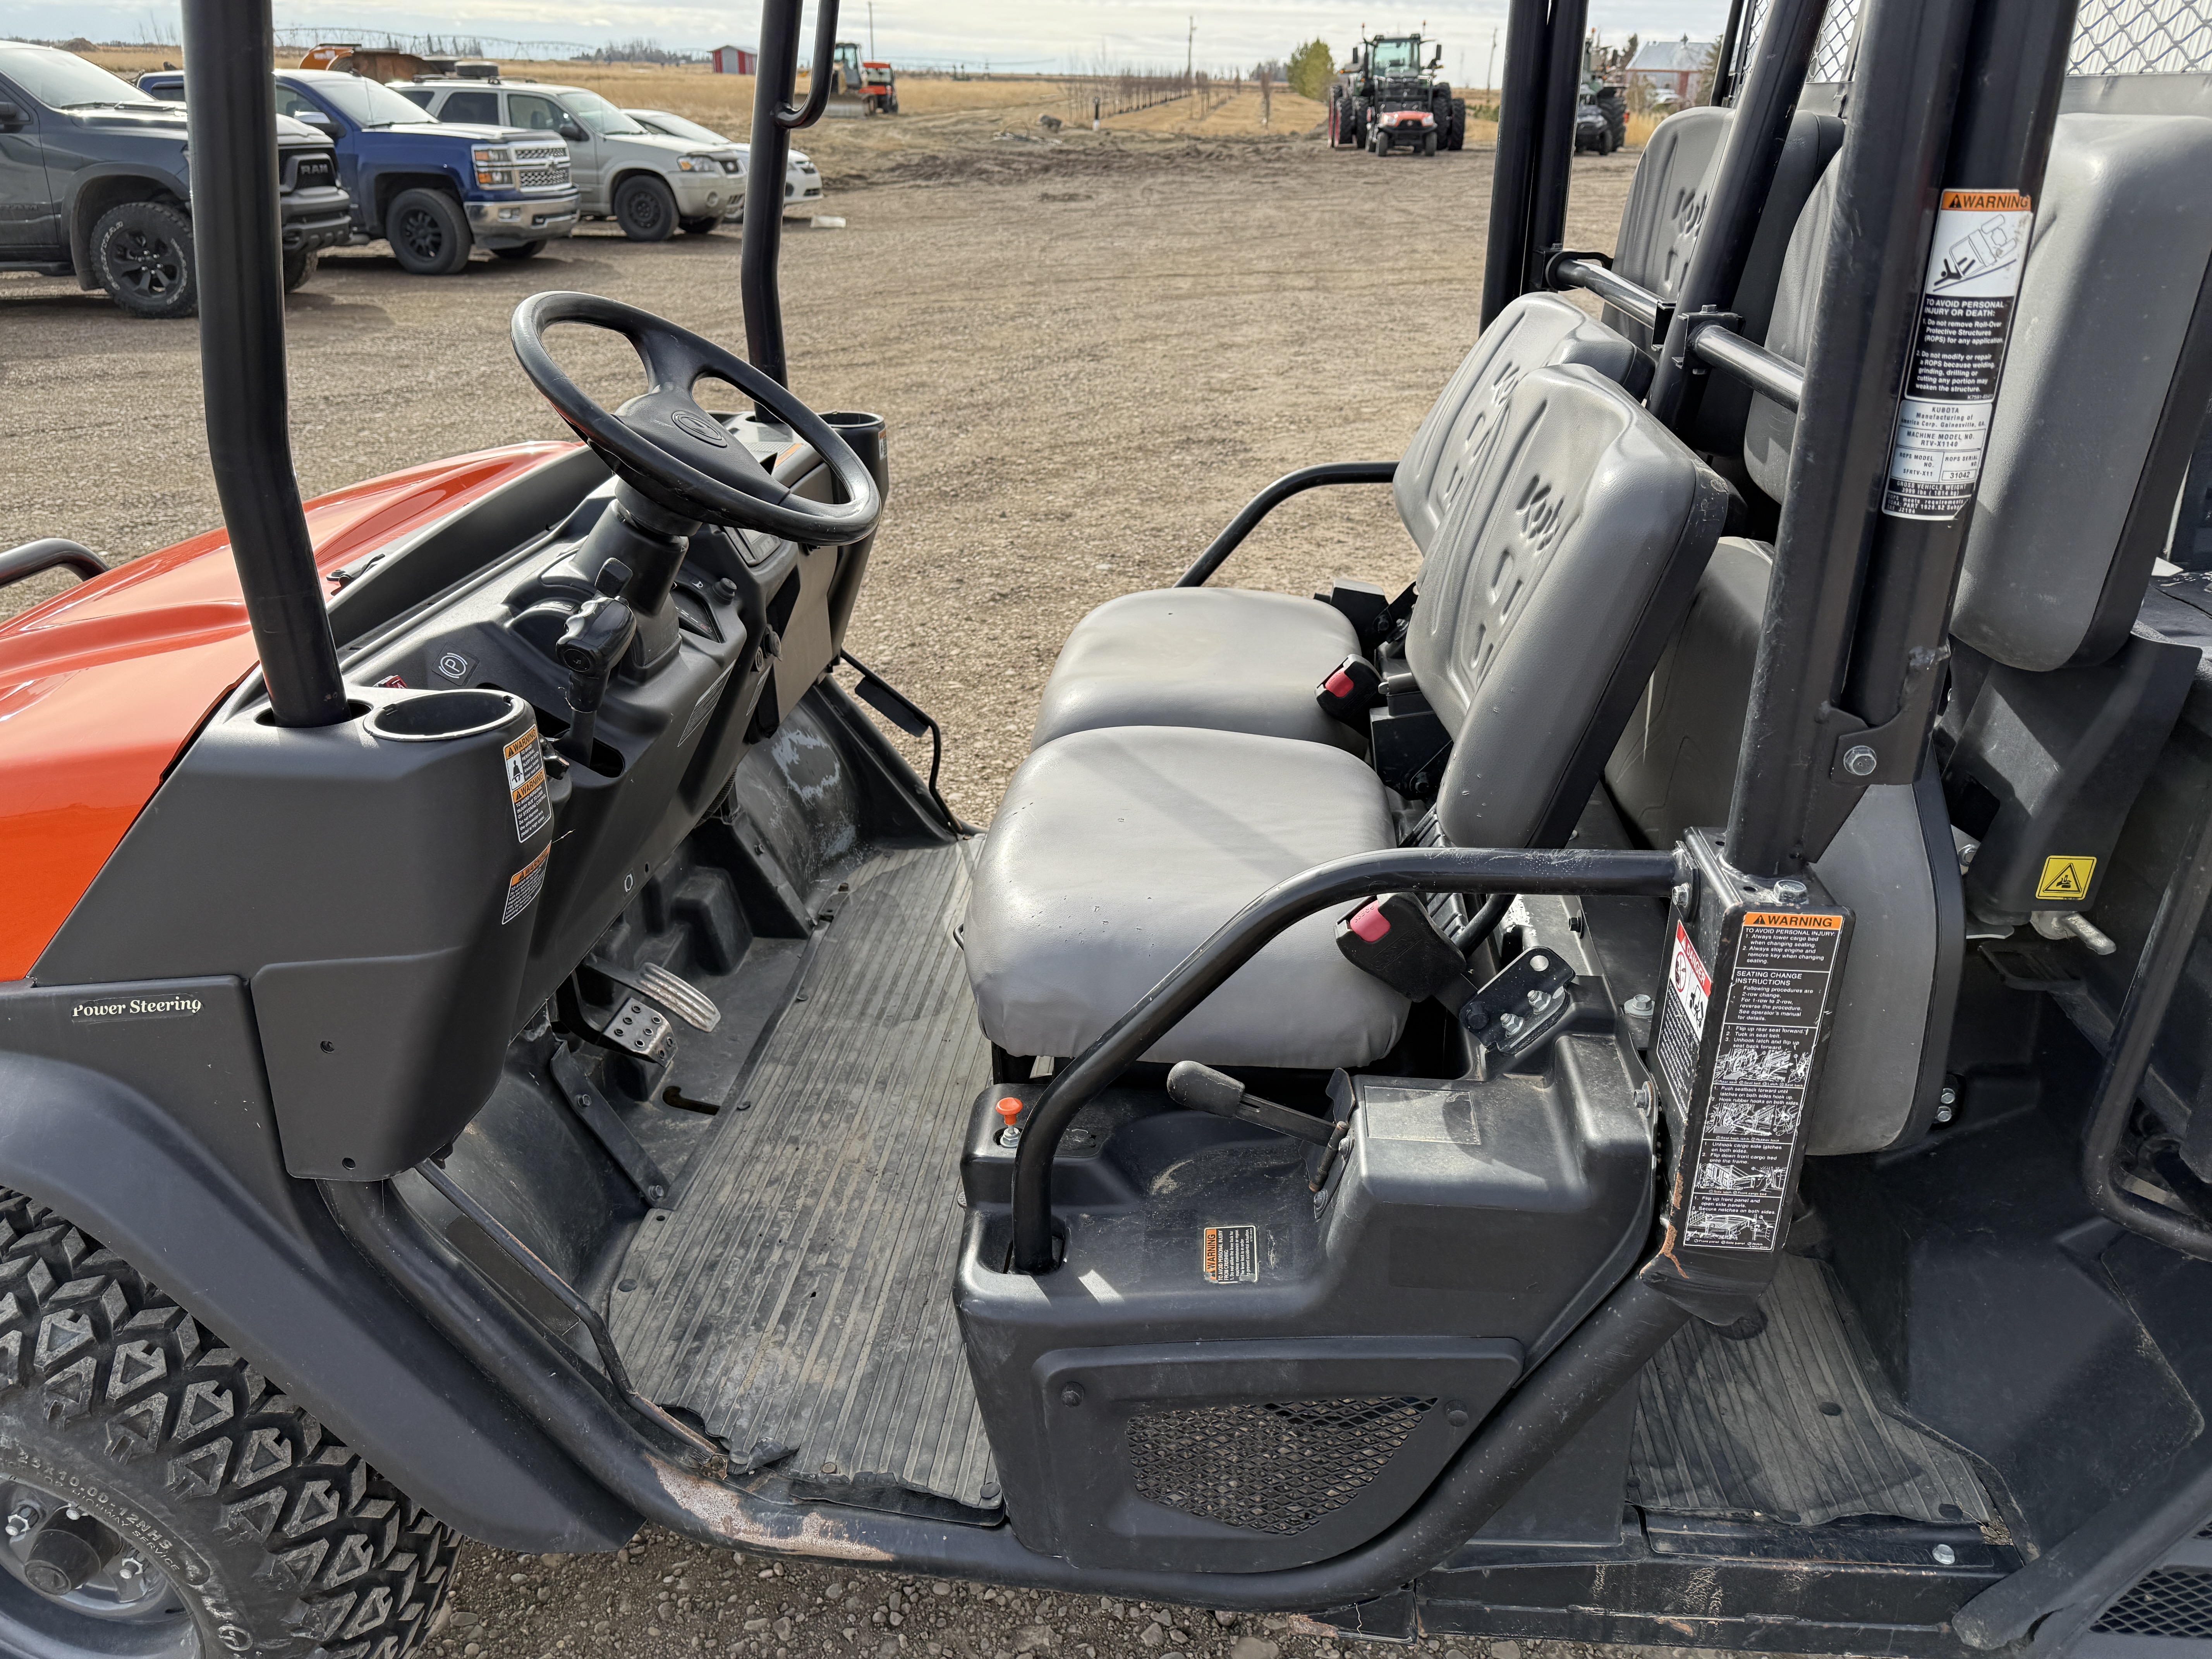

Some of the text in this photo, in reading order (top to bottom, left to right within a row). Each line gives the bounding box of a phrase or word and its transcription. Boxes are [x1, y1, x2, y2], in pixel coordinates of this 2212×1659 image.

[301, 164, 328, 174] RAM
[1964, 195, 2030, 209] WARNING
[1926, 327, 1956, 335] Protective
[1924, 335, 1946, 343] (ROPS)
[1918, 368, 1944, 376] grinding,
[1917, 375, 1937, 384] cutting
[1916, 412, 1964, 421] Manufacturing
[1940, 419, 1976, 428] Gainesville,
[1906, 430, 1935, 439] MACHINE
[1949, 470, 1970, 480] 31042
[1917, 482, 1943, 490] VEHICLE
[1945, 482, 1966, 490] WEIGHT
[513, 729, 536, 752] WARNING
[521, 771, 543, 795] WARNING
[1355, 905, 1375, 923] PRESS
[1768, 915, 1832, 927] WARNING
[1686, 943, 1705, 985] DANGER
[73, 996, 202, 1017] Power Steering
[1207, 1234, 1215, 1269] WARNING
[132, 1530, 180, 1571] SERVICE
